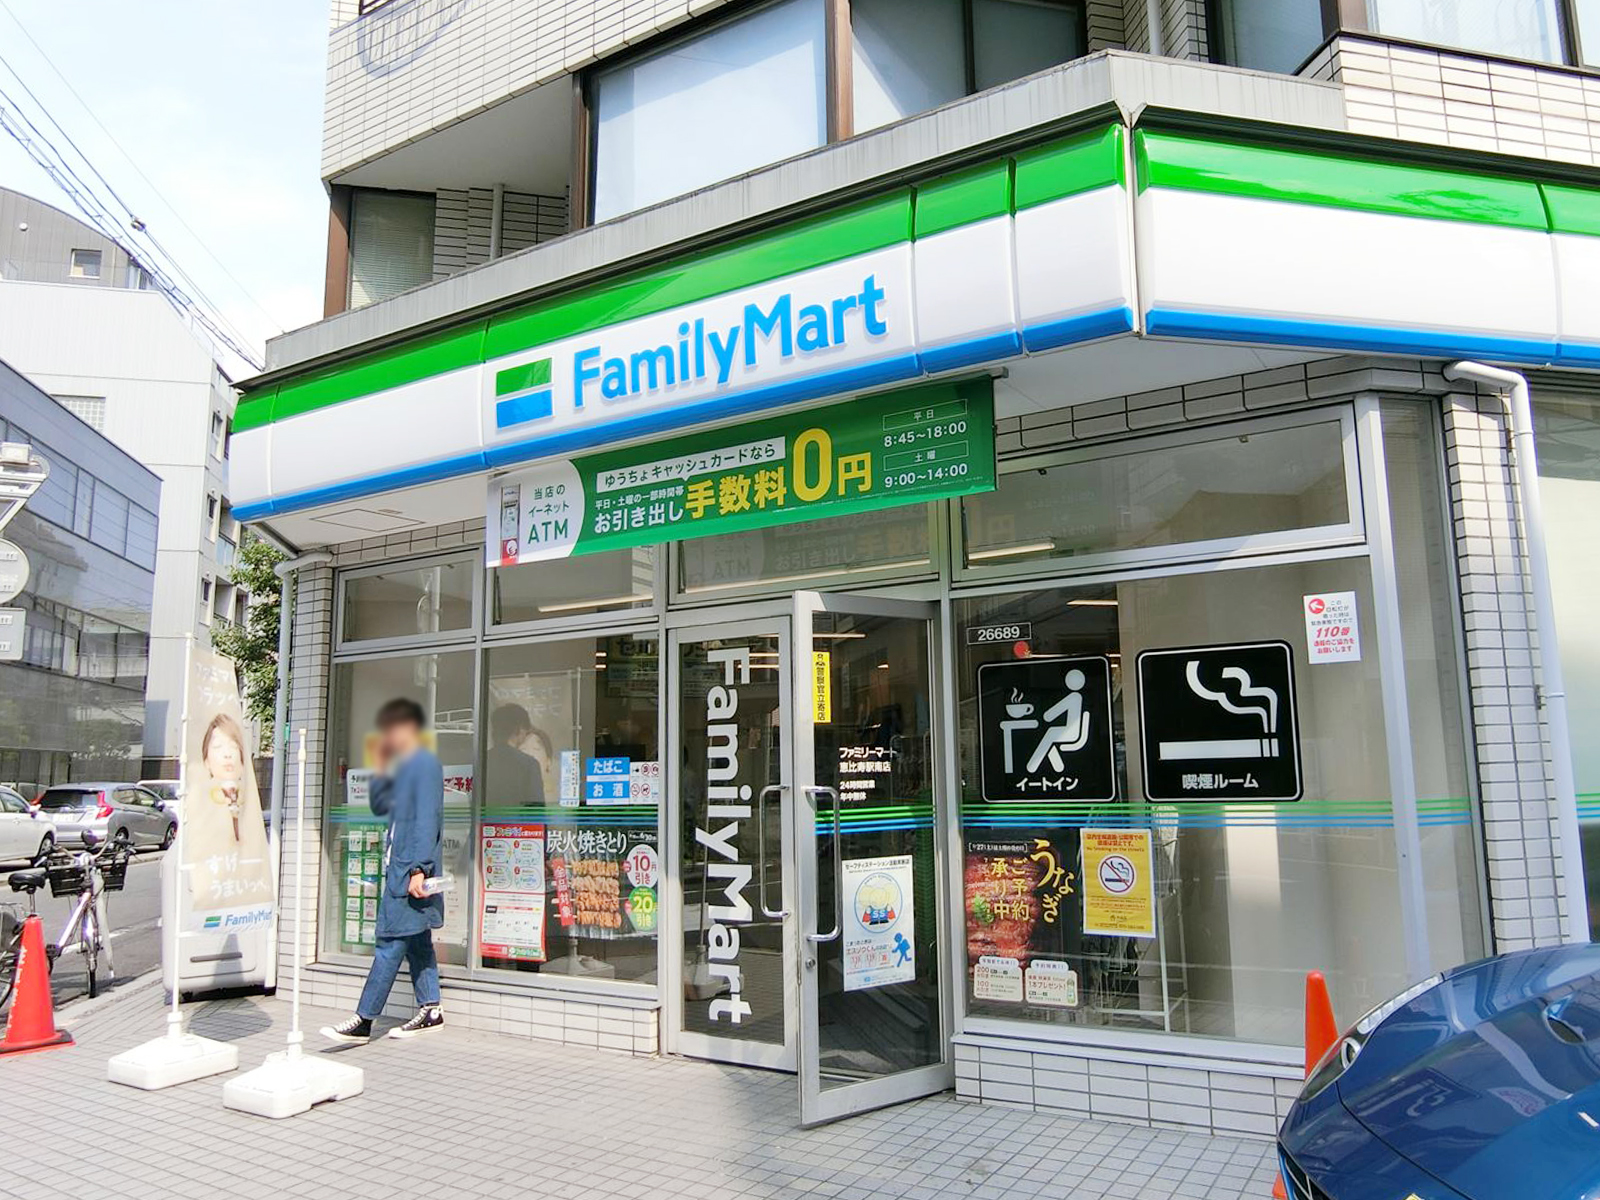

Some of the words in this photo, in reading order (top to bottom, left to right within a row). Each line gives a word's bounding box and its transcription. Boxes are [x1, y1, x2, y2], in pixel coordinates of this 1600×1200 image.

[574, 274, 887, 407] FamilyMart
[913, 409, 934, 421] 平日
[604, 443, 776, 489] ゆうちょキャッシュカードなら
[914, 450, 937, 463] 土曜
[534, 484, 566, 500] 当店の
[595, 486, 685, 511] 平日・土曜の一部時間帯
[528, 501, 570, 518] イーネット
[594, 501, 684, 534] お引き出し
[528, 518, 569, 545] ATM
[976, 626, 1022, 642] 26689
[839, 746, 895, 759] ファミリーマート
[592, 760, 623, 774] たばこ
[1015, 776, 1079, 792] イートイン
[1181, 772, 1259, 790] 喫煙ルーム
[546, 830, 628, 855] 炭火焼きとり
[695, 646, 753, 1024] FamilyMart
[991, 857, 1010, 921] 承り中
[1011, 857, 1030, 921] ご予約
[1030, 838, 1075, 923] うなぎ
